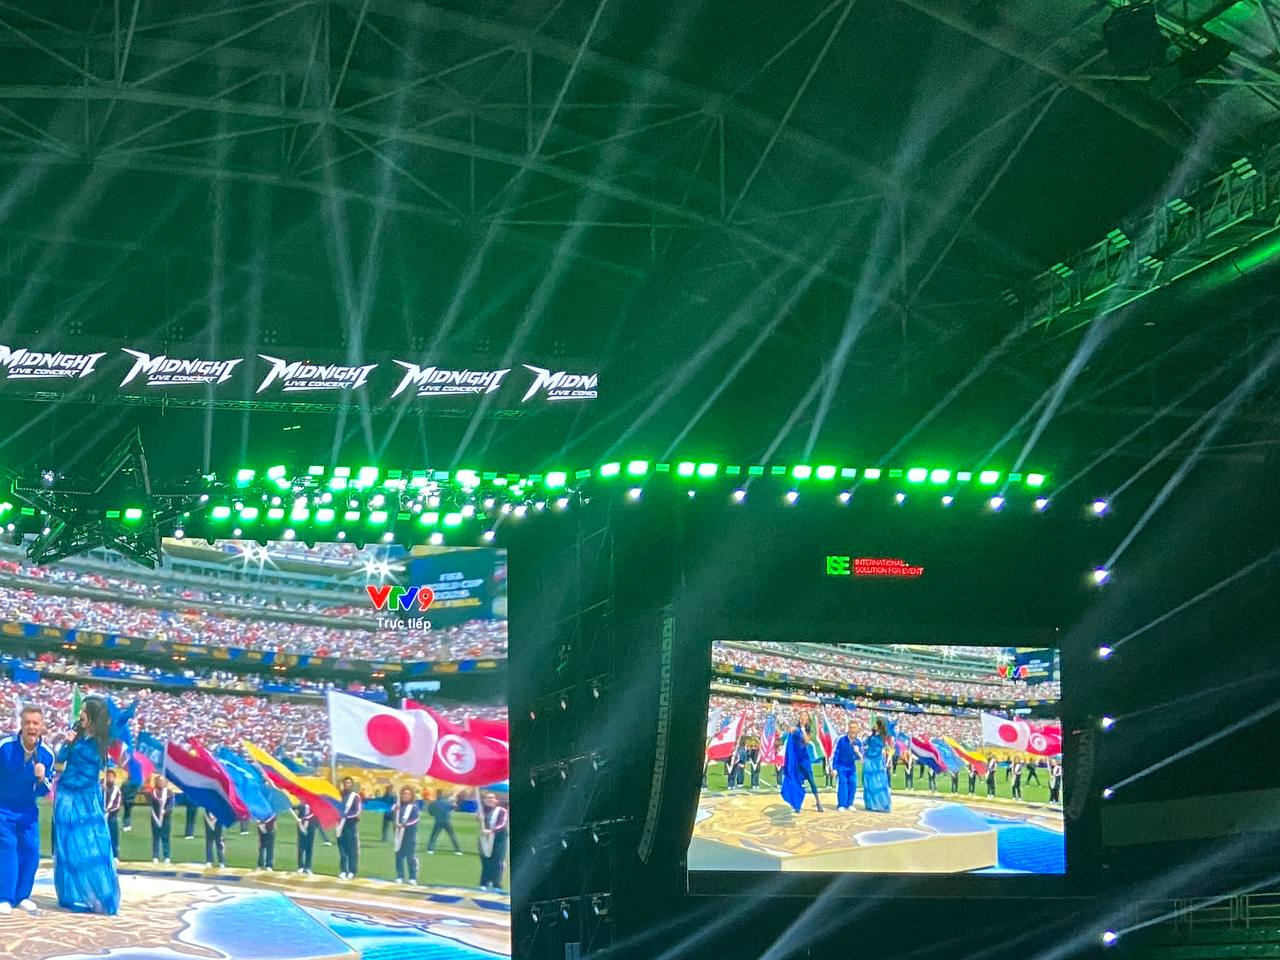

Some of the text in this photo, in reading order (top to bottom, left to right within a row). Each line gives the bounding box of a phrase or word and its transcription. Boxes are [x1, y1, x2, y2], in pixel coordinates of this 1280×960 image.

[119, 347, 244, 388] MIDNIGHT
[33, 369, 80, 378] CONCERT
[256, 354, 379, 393] MIDNIGHT
[391, 359, 512, 398] MIDNIGHT
[172, 375, 218, 384] CONCERT
[308, 381, 353, 389] CONCERT
[442, 386, 487, 394] CONCERT
[854, 558, 906, 567] INTERNATIONAL
[854, 566, 924, 576] SOLUTION FOR EVENT
[366, 585, 434, 612] VTV9
[376, 616, 432, 631] Trực tiếp
